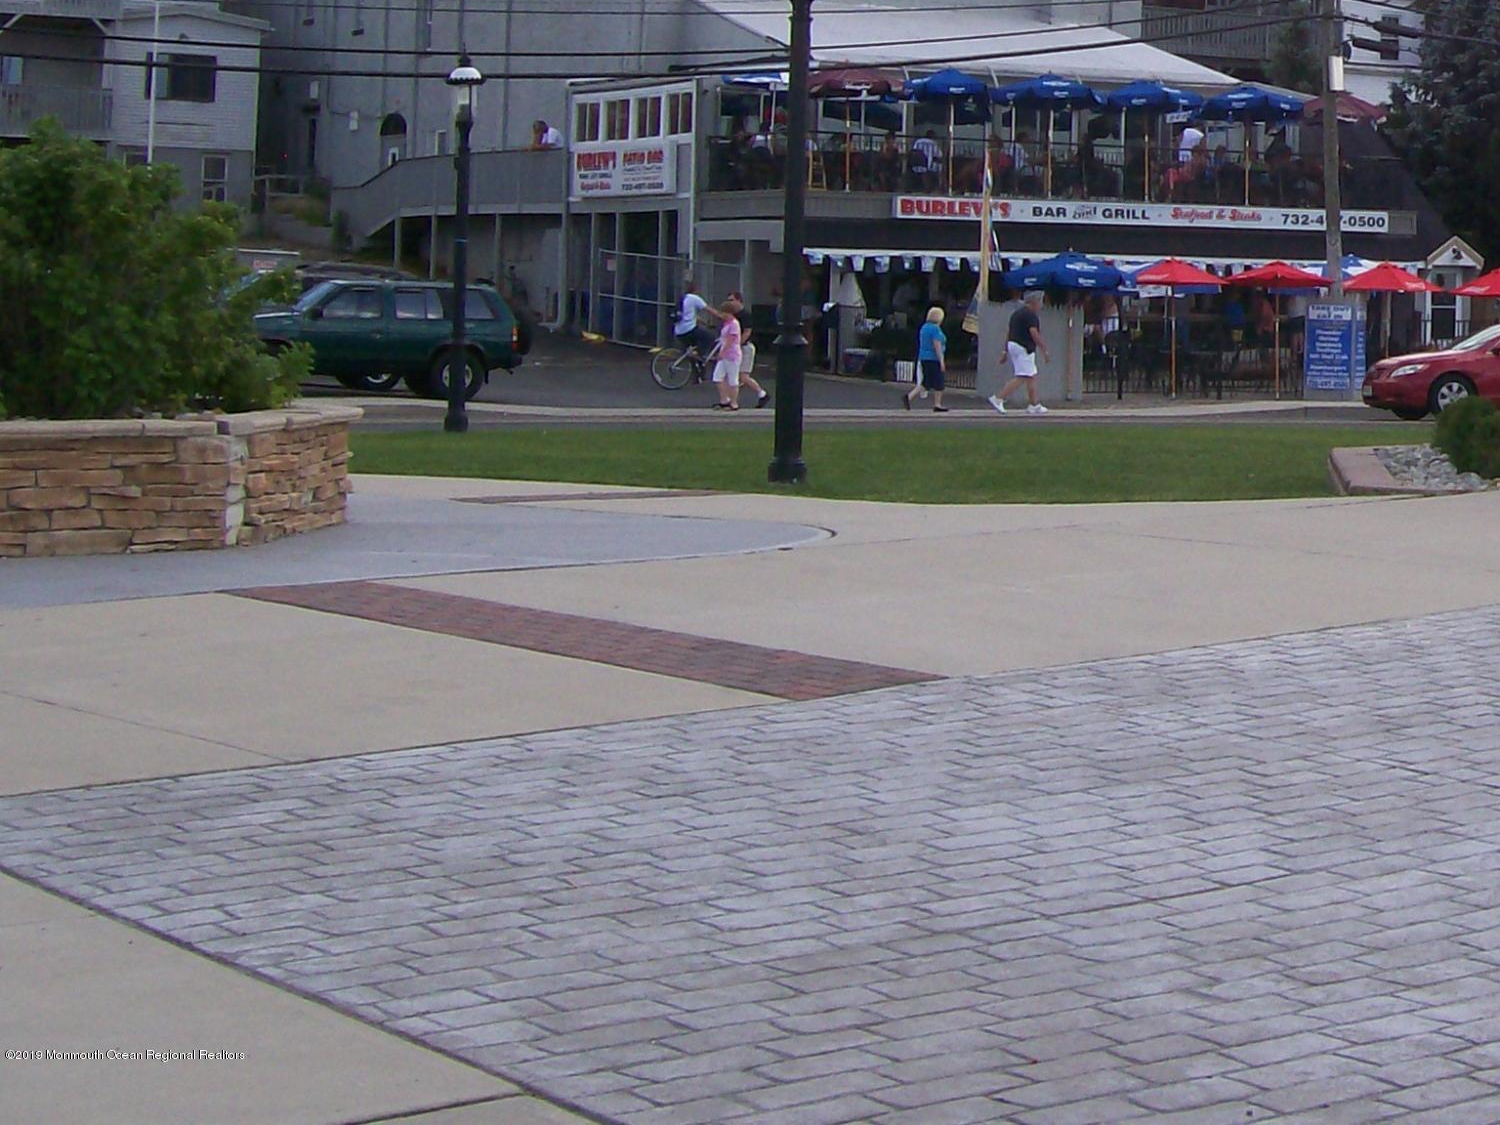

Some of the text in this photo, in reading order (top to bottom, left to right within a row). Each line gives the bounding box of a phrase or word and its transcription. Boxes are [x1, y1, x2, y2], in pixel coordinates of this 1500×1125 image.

[1032, 206, 1067, 218] BAR
[1072, 205, 1097, 220] and
[1101, 208, 1151, 220] GRILL
[1171, 207, 1214, 223] Seafood
